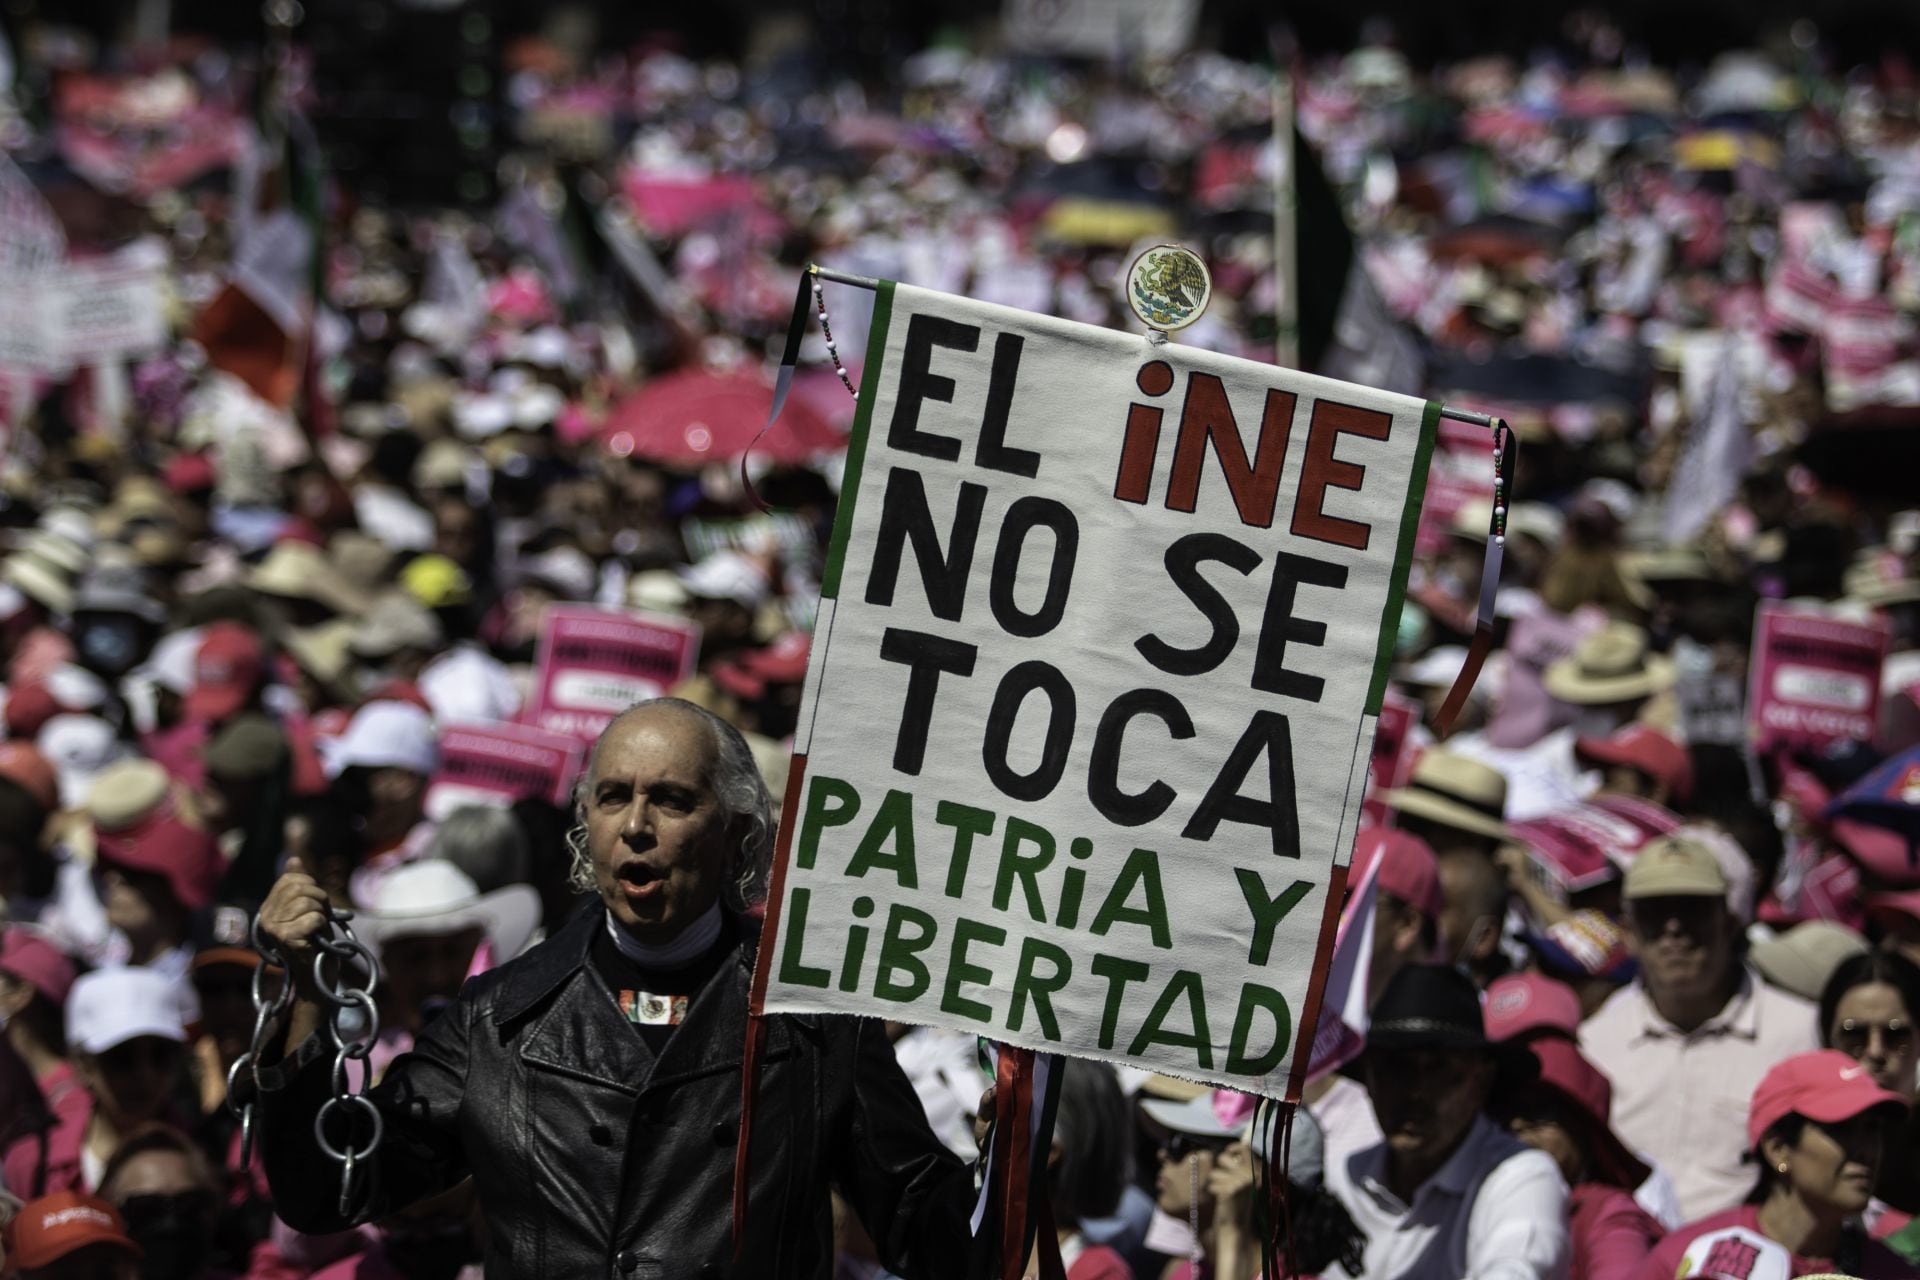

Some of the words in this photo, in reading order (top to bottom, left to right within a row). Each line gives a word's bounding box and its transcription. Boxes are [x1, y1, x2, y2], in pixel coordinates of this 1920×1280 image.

[887, 313, 1041, 479] EL
[1113, 359, 1394, 551] iNE
[864, 466, 1079, 638] NO
[1134, 532, 1349, 703] SE
[879, 627, 1301, 860] TOCA
[778, 887, 1292, 1075] LiBERTAD
[796, 775, 1173, 950] PATRiA
[1233, 867, 1315, 967] Y
